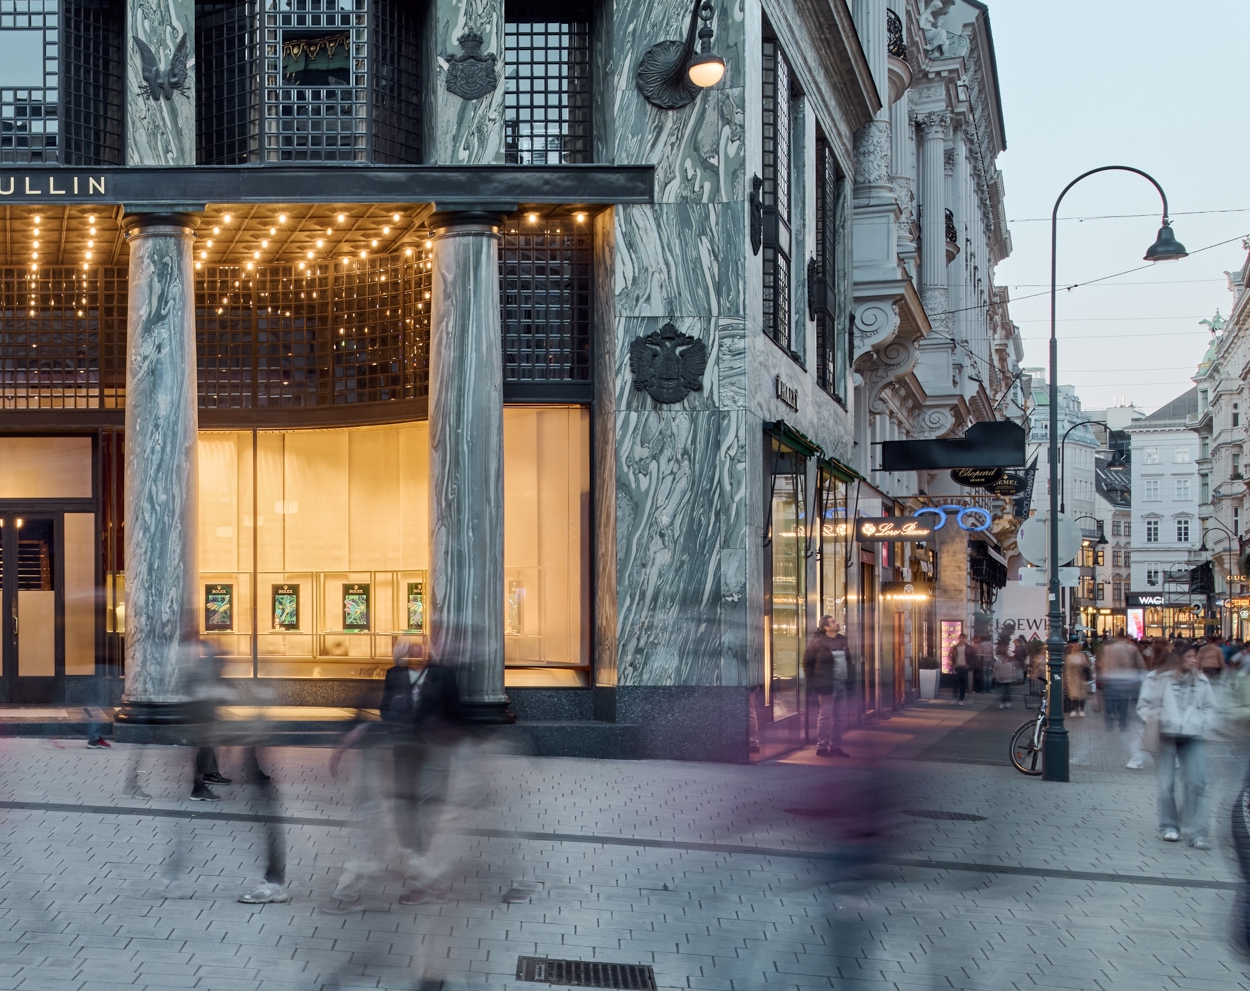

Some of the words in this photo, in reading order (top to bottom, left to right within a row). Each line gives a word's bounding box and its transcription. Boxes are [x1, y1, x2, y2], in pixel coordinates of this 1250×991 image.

[956, 467, 997, 478] Chopard
[875, 522, 901, 536] Loro
[901, 521, 930, 536] Piana
